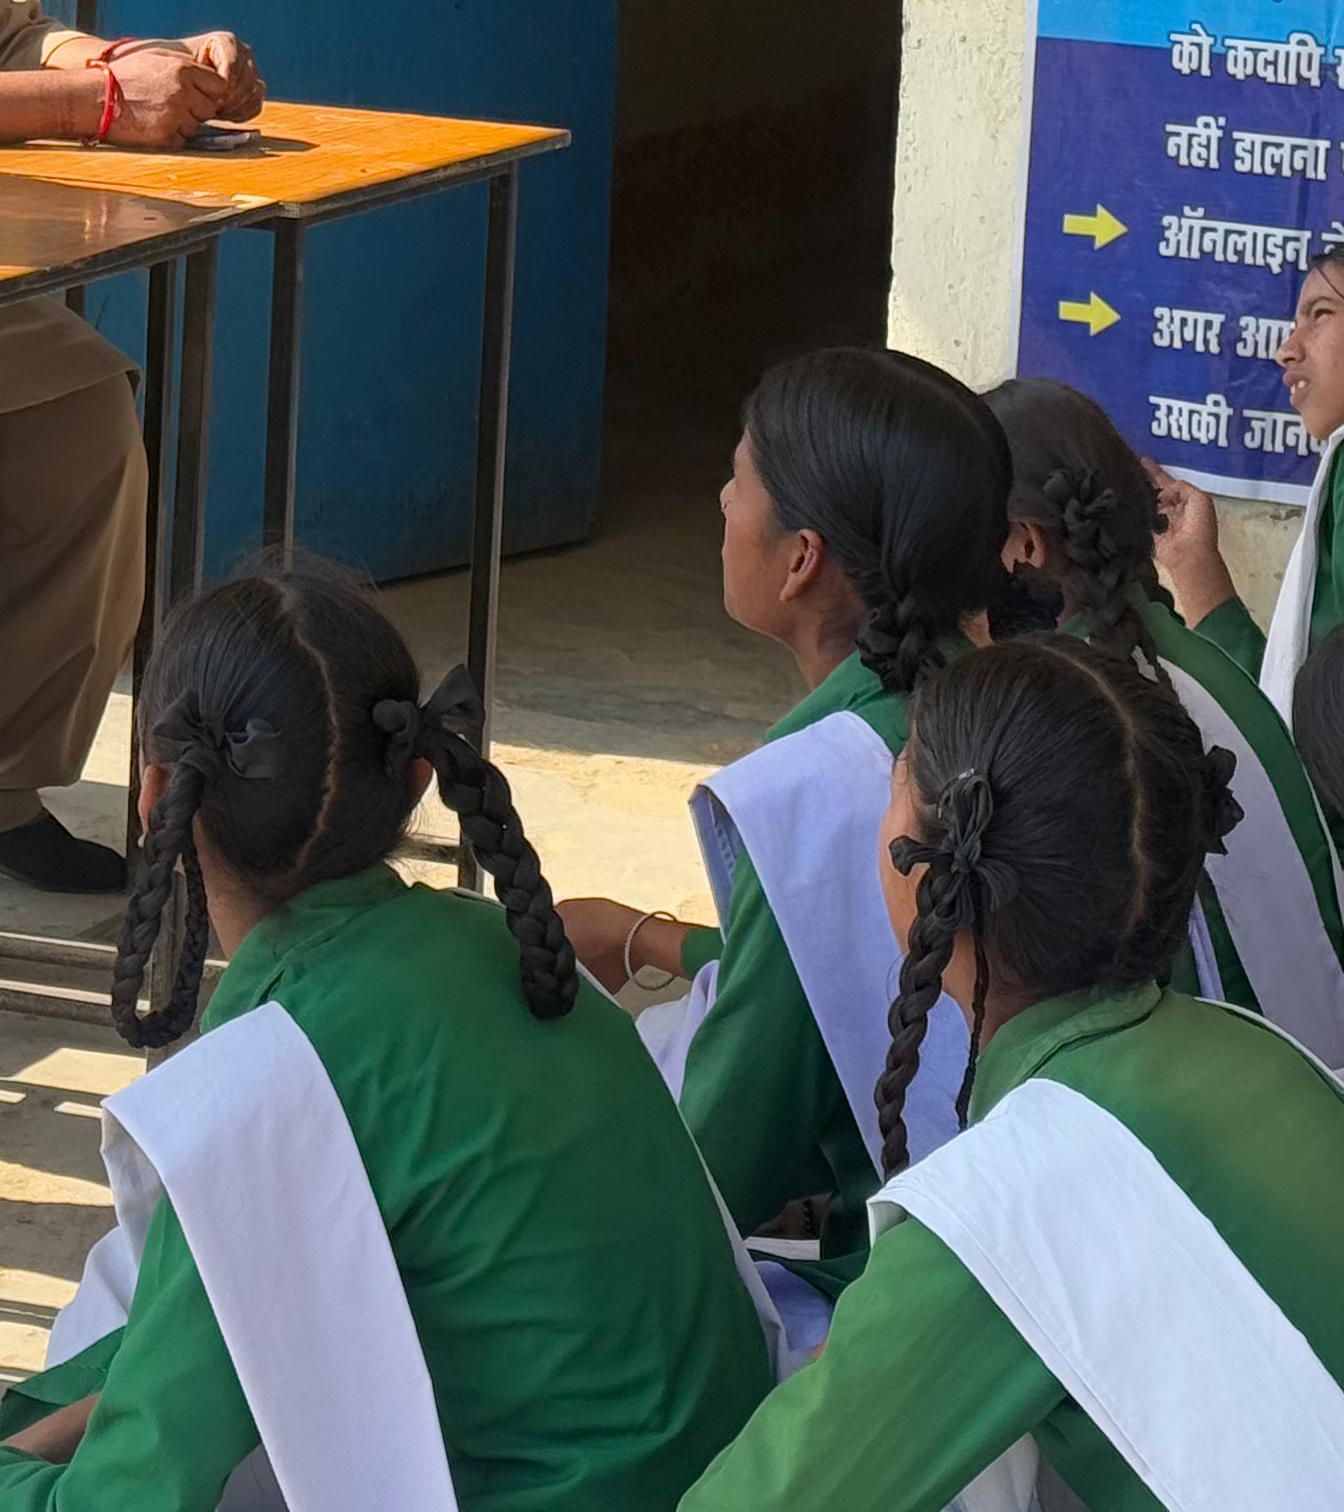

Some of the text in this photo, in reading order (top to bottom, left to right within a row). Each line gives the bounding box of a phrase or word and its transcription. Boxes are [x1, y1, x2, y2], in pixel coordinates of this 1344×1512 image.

[1169, 23, 1214, 77] को
[1224, 32, 1325, 87] कदापि
[1165, 115, 1226, 169] नहीं
[1232, 131, 1331, 181] डालना
[1158, 205, 1312, 274] ऑनलाइन
[1153, 306, 1226, 354] अगर
[1148, 393, 1234, 447] उसकी
